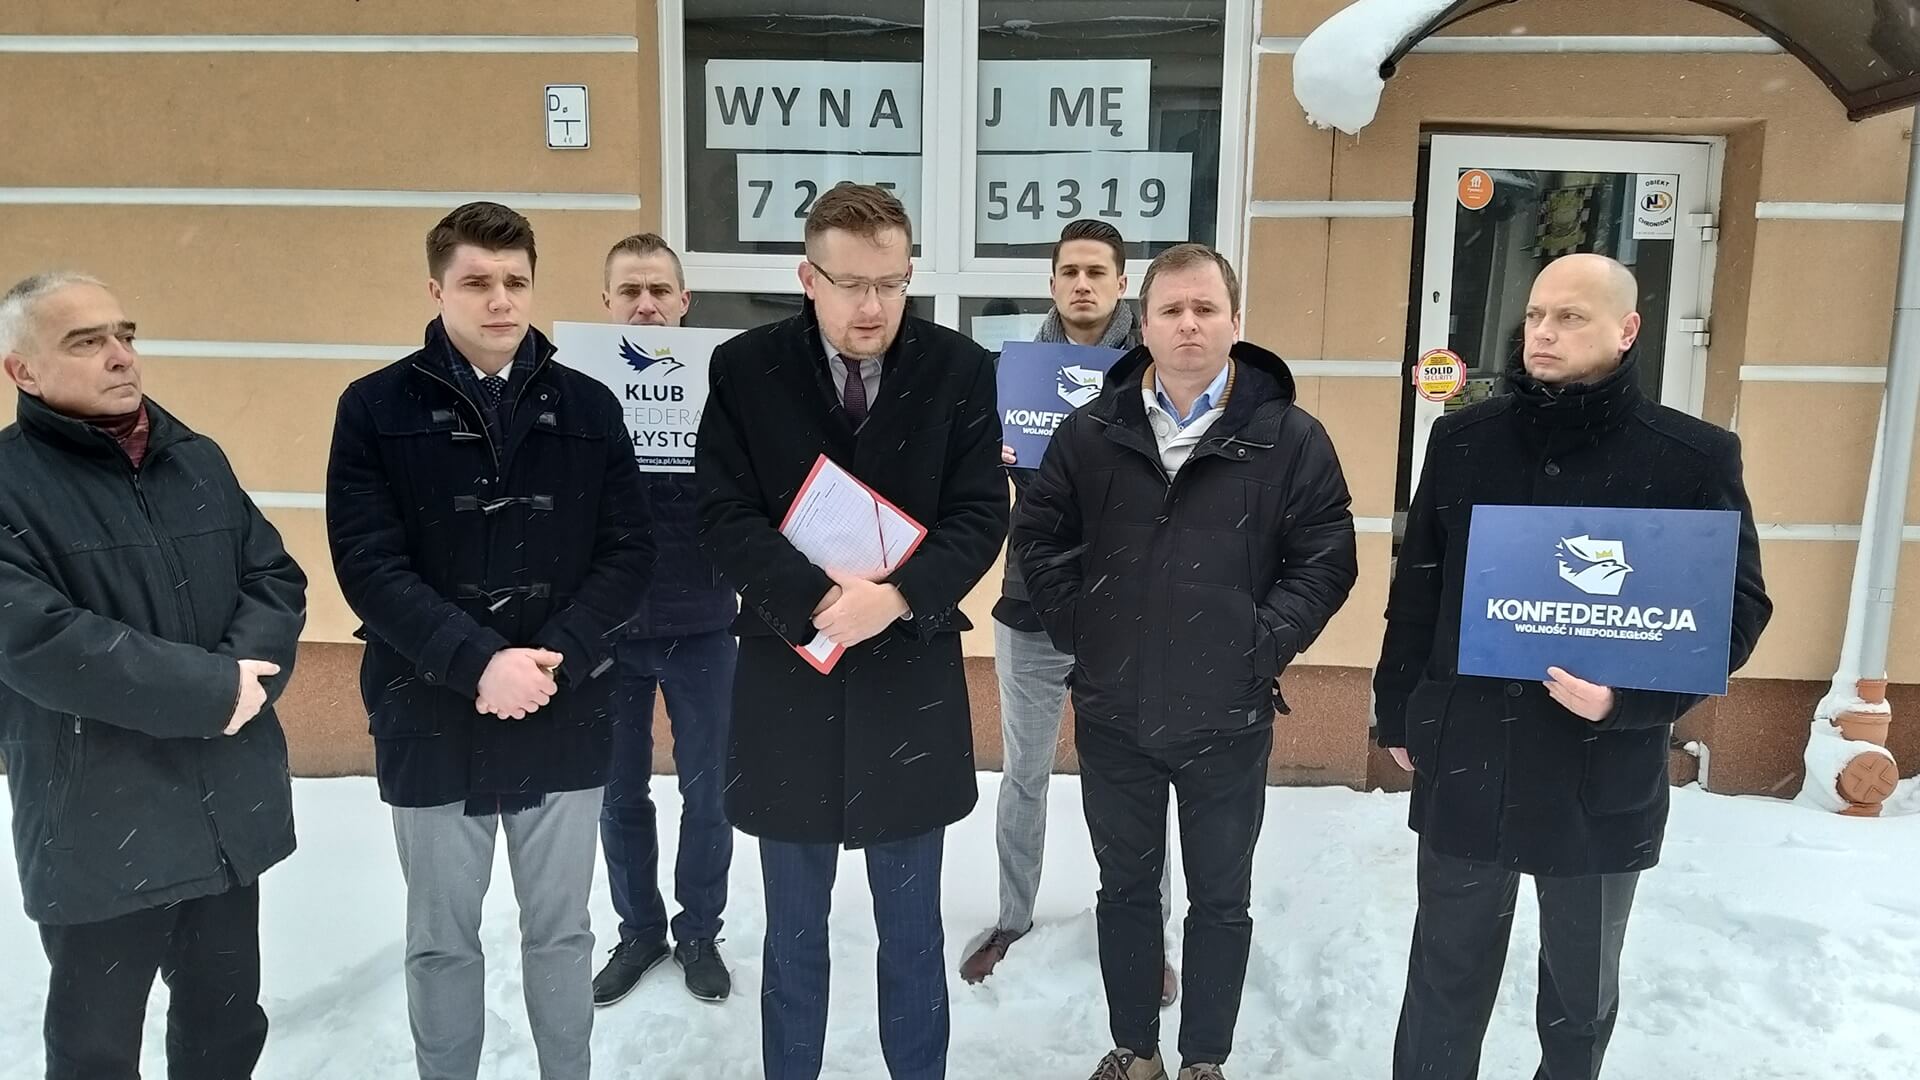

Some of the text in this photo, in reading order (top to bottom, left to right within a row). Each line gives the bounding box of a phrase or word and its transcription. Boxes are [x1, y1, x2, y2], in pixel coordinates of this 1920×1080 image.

[1049, 87, 1124, 137] MĘ
[987, 178, 1166, 220] 54319
[1638, 216, 1672, 227] CHRONIONY
[1424, 366, 1453, 375] SOLID
[625, 383, 684, 402] KLUB
[1487, 599, 1697, 631] KONFEDERACJA
[1515, 623, 1664, 642] WOLNOŚĆ I NIEPODLEGŁOŚĆ
